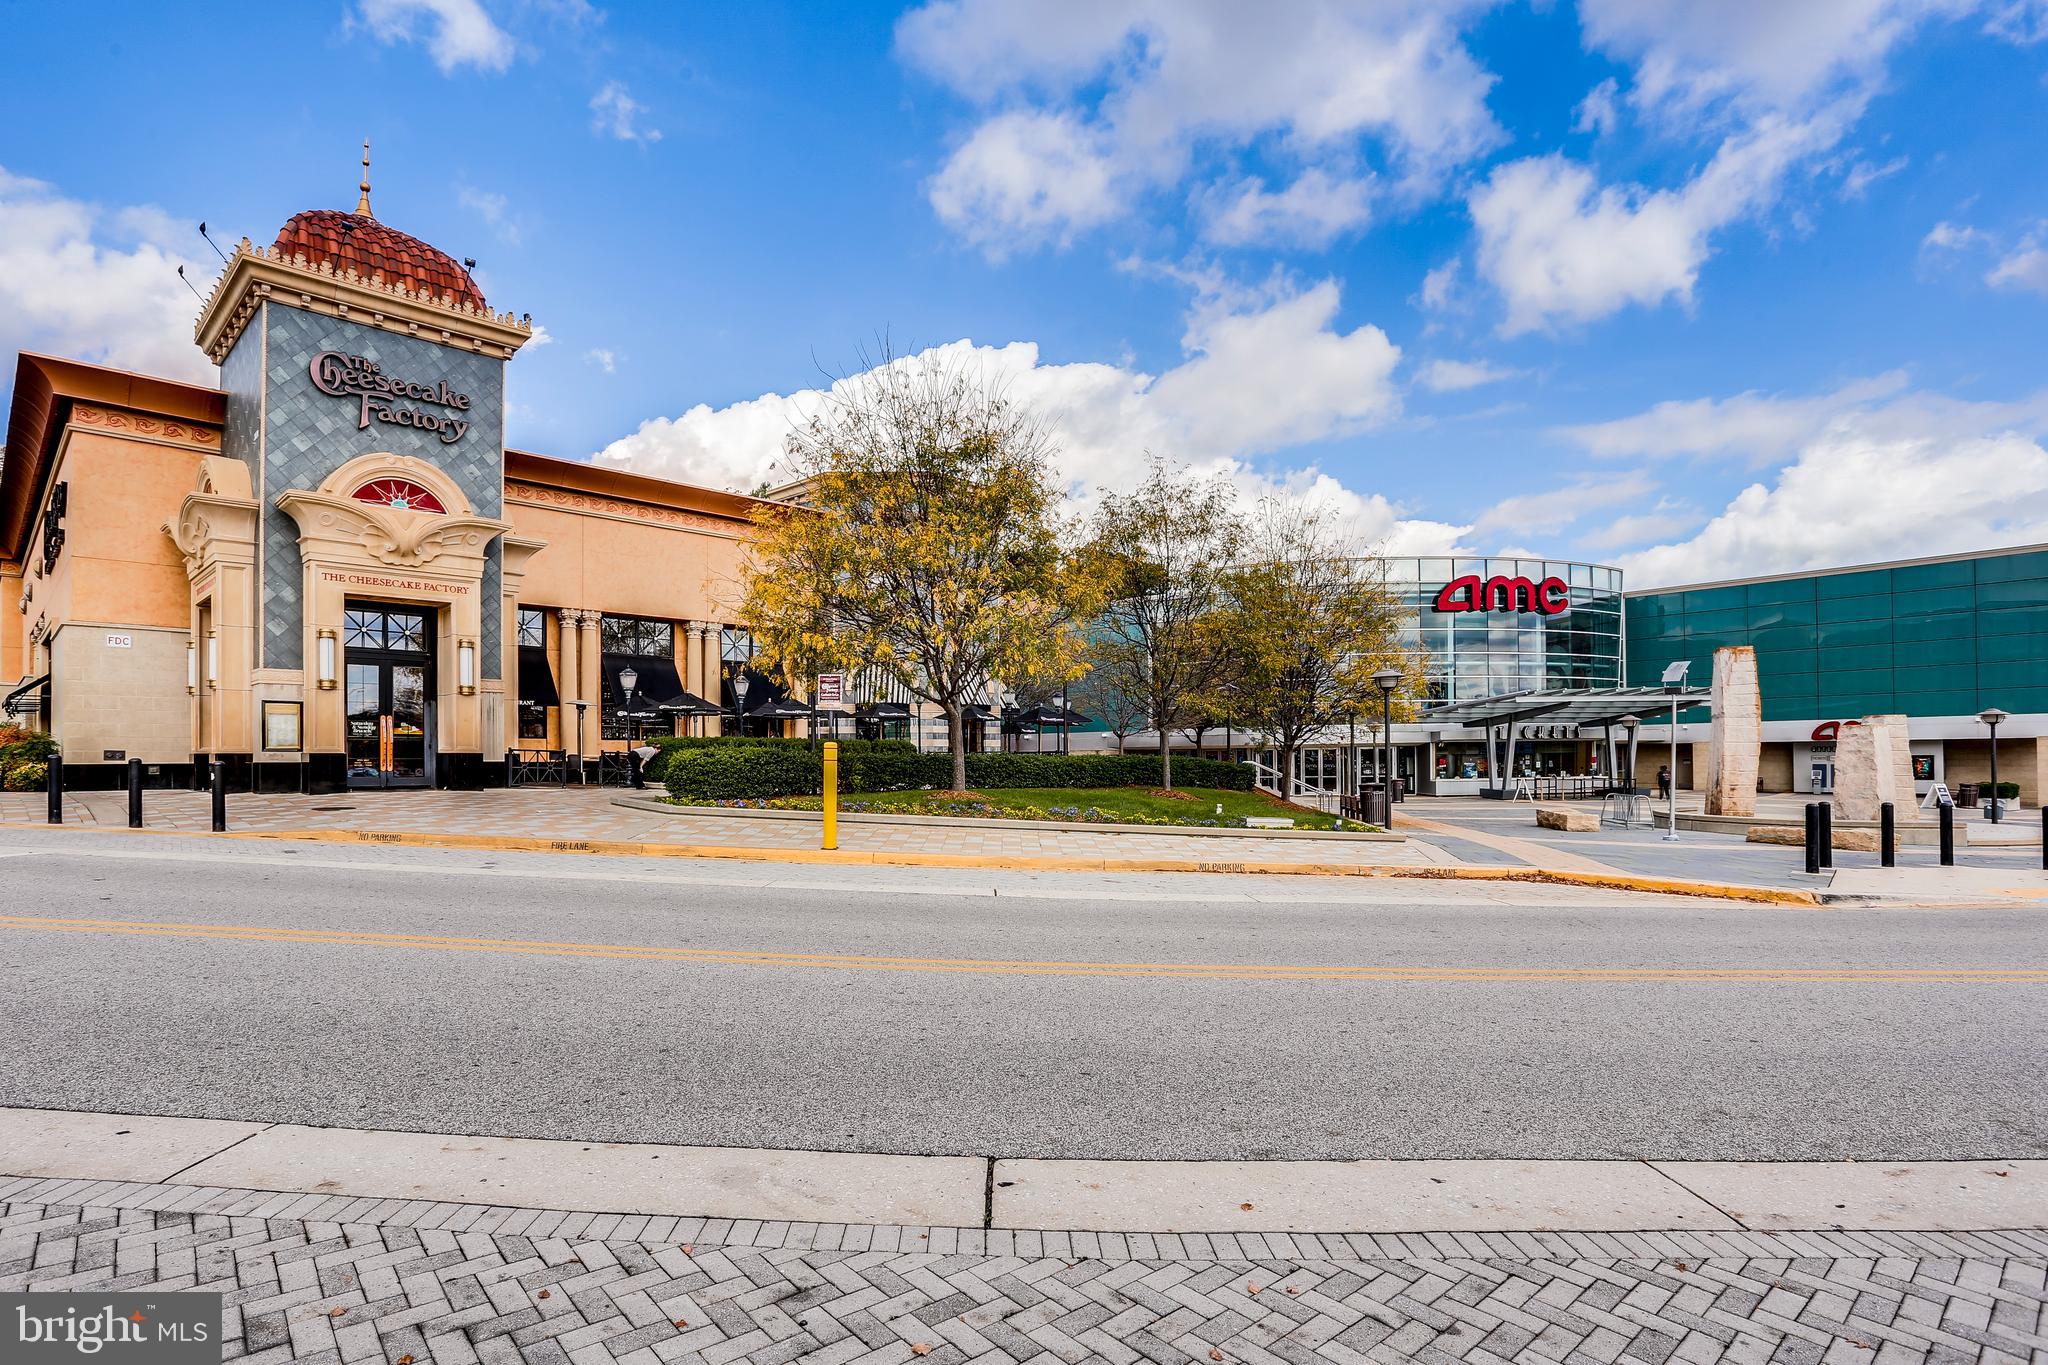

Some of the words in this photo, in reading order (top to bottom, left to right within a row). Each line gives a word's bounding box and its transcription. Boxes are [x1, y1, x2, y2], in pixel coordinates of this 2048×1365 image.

[350, 355, 381, 373] The
[309, 350, 471, 410] Cheesecake
[344, 384, 469, 444] Factory
[321, 572, 346, 582] THE
[348, 575, 421, 590] CHEESECAKE
[423, 583, 470, 595] FACTORY
[1435, 574, 1569, 615] amc
[108, 636, 130, 646] FDC
[1494, 725, 1582, 740] TCKETS
[358, 832, 369, 841] NO
[371, 833, 402, 842] PARKING
[551, 841, 567, 850] FIRE
[569, 842, 589, 850] LANE
[1199, 862, 1209, 871] NO
[1212, 863, 1245, 873] PARKING
